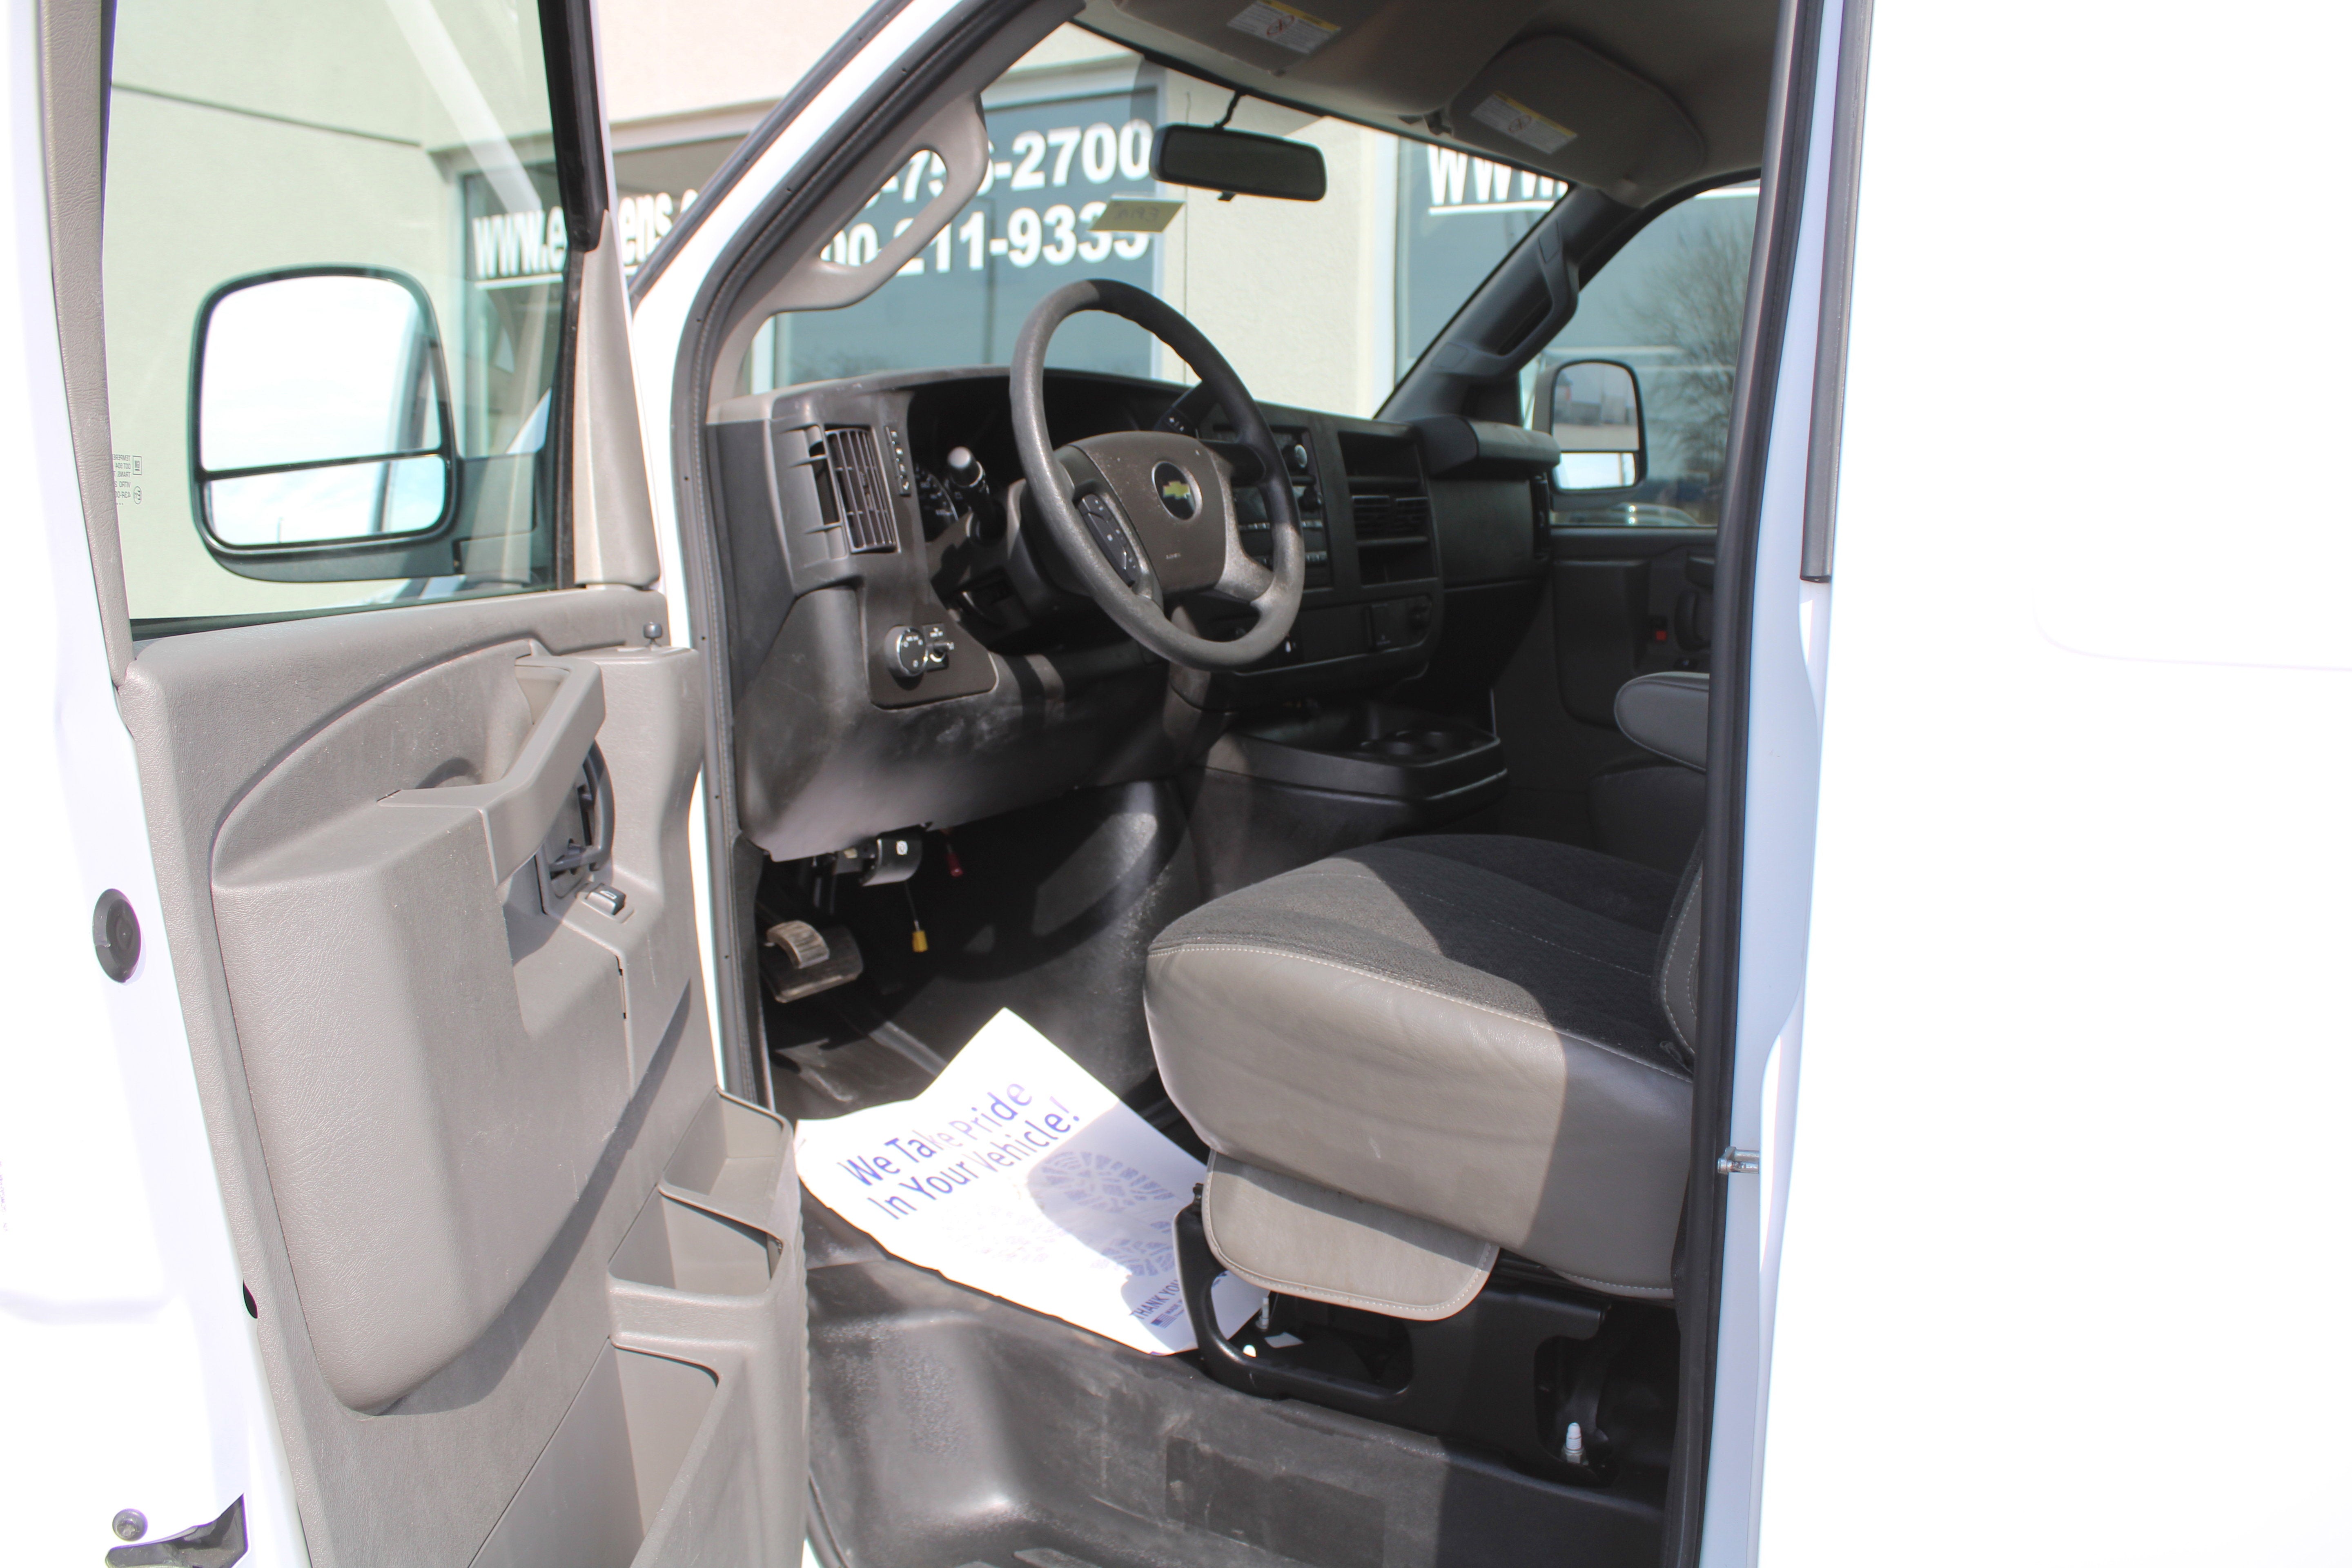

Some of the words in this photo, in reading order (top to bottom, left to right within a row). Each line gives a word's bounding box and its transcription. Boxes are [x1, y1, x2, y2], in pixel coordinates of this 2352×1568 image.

[837, 1156, 901, 1186] We
[884, 1129, 963, 1163] Take
[949, 1083, 1033, 1140] Pride
[866, 1196, 917, 1220] In
[898, 1161, 980, 1200] Your
[962, 1095, 1080, 1173] Vehicle!
[1129, 1294, 1170, 1319] THANK
